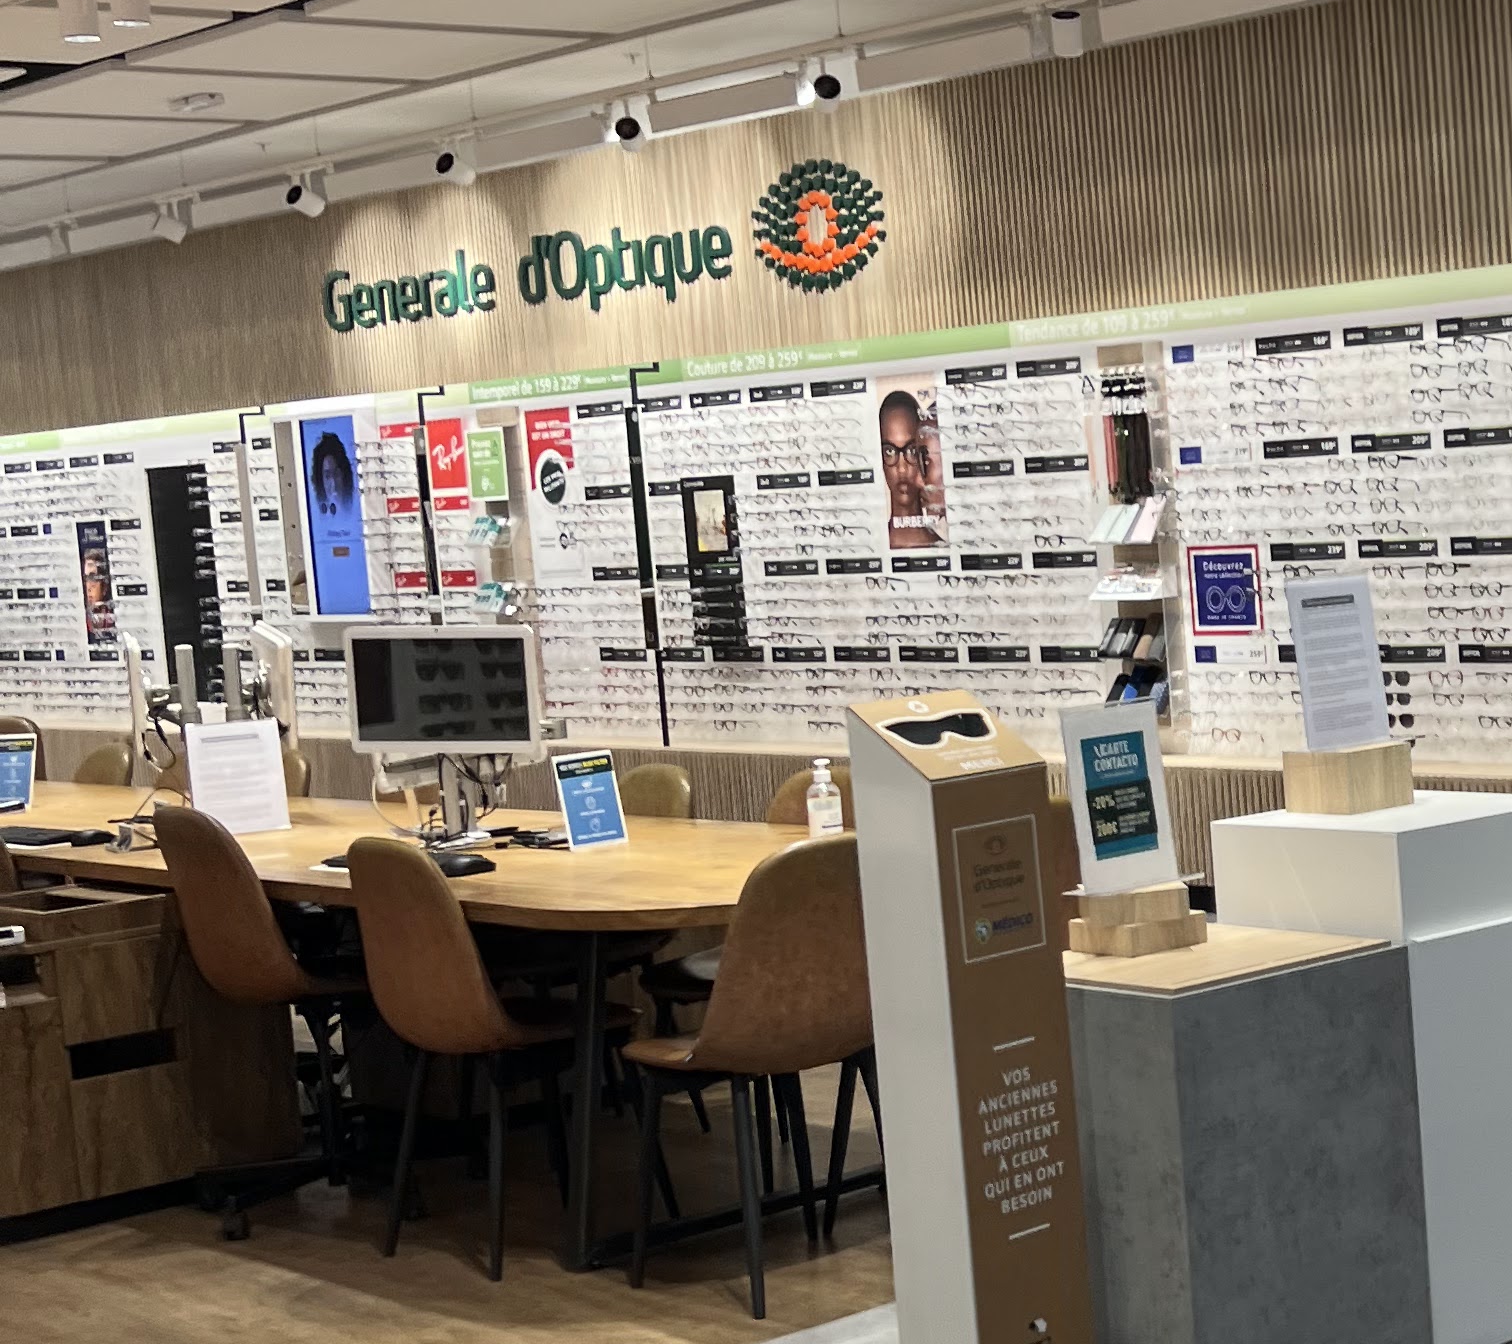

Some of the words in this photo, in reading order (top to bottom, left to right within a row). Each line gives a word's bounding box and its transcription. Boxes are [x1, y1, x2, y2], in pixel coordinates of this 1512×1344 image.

[322, 249, 496, 334] Generale
[518, 225, 734, 312] d'Optique
[1002, 1066, 1031, 1086] VOS
[978, 1079, 1058, 1115] ANCIENNES
[984, 1101, 1056, 1135] LUNETTES
[983, 1120, 1060, 1156] PROFITENT
[999, 1154, 1009, 1172] À
[1012, 1145, 1049, 1169] CEUX
[984, 1177, 1011, 1200] QUI
[1014, 1170, 1033, 1189] EN
[1036, 1161, 1065, 1182] ONT
[1001, 1185, 1053, 1214] BESOIN
